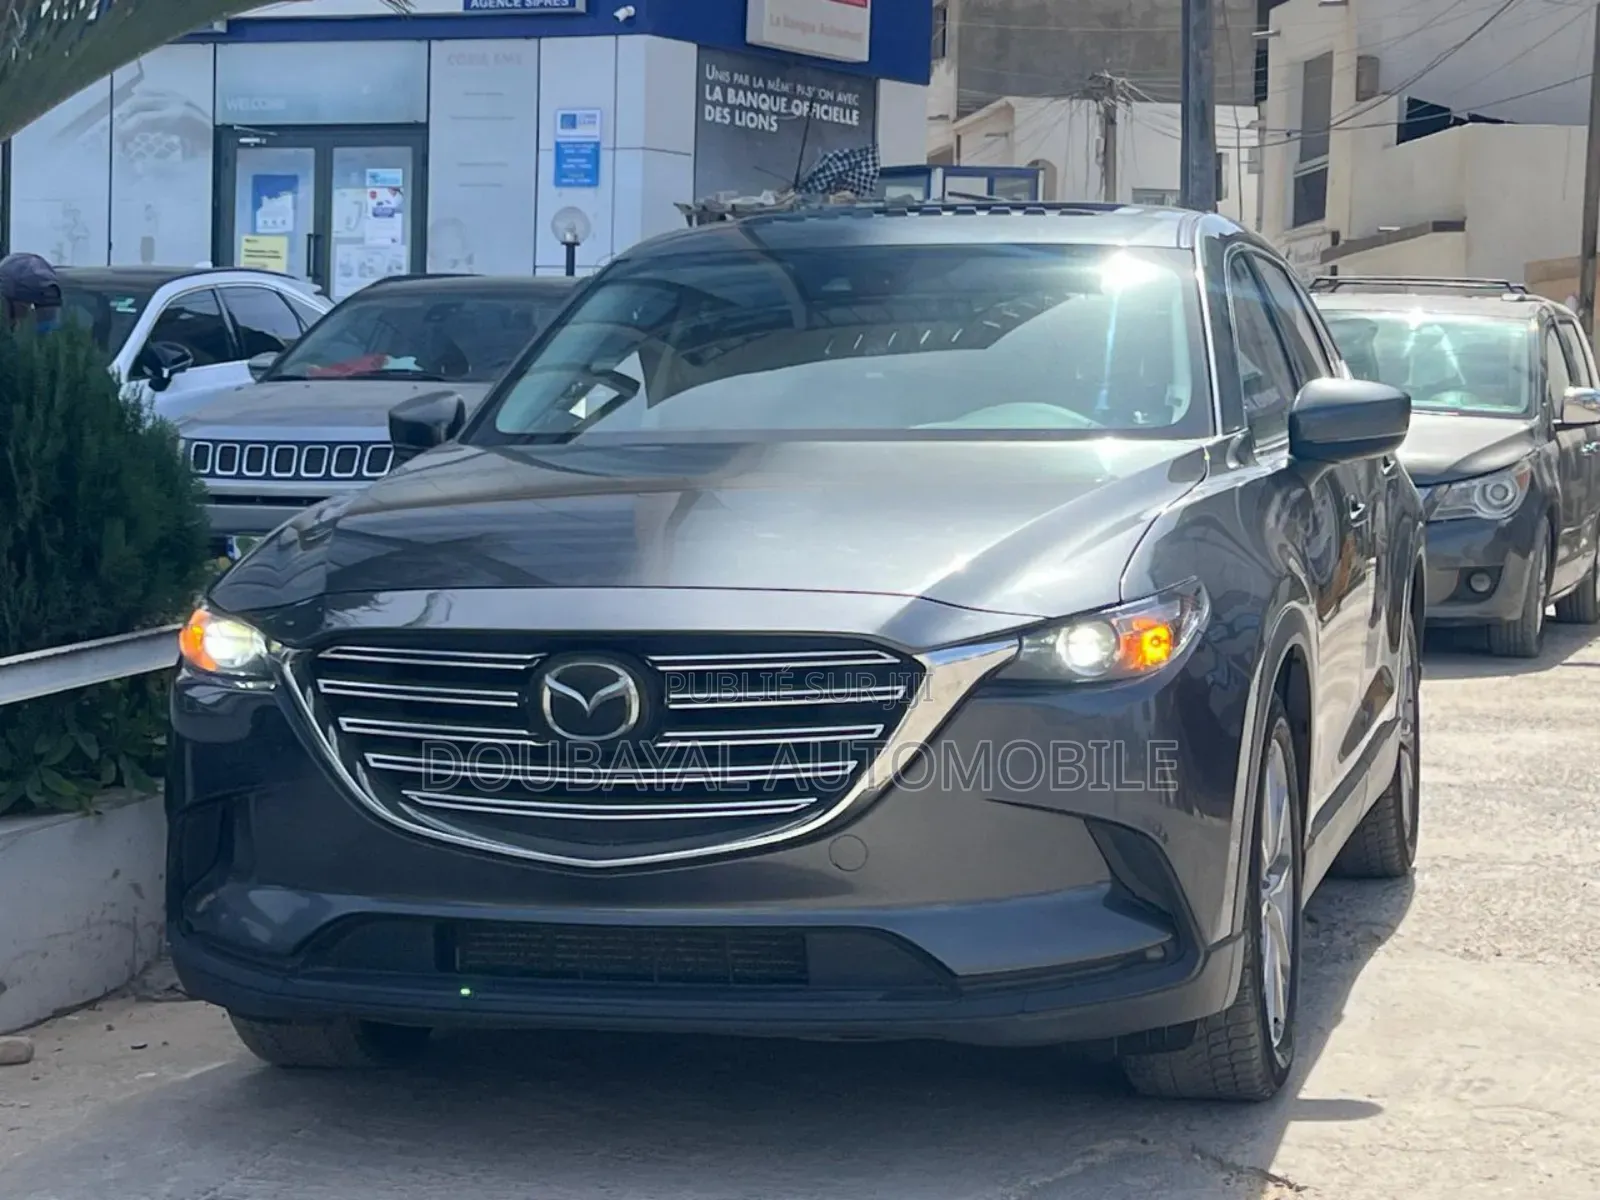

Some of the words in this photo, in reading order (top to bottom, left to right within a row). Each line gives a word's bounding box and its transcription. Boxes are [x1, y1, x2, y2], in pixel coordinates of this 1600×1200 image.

[705, 85, 723, 103] LA
[727, 87, 788, 113] BANQUE
[733, 73, 749, 87] PAR
[752, 76, 764, 88] LA
[837, 91, 859, 106] AVEC
[704, 104, 731, 125] DES
[735, 109, 778, 132] LIONS
